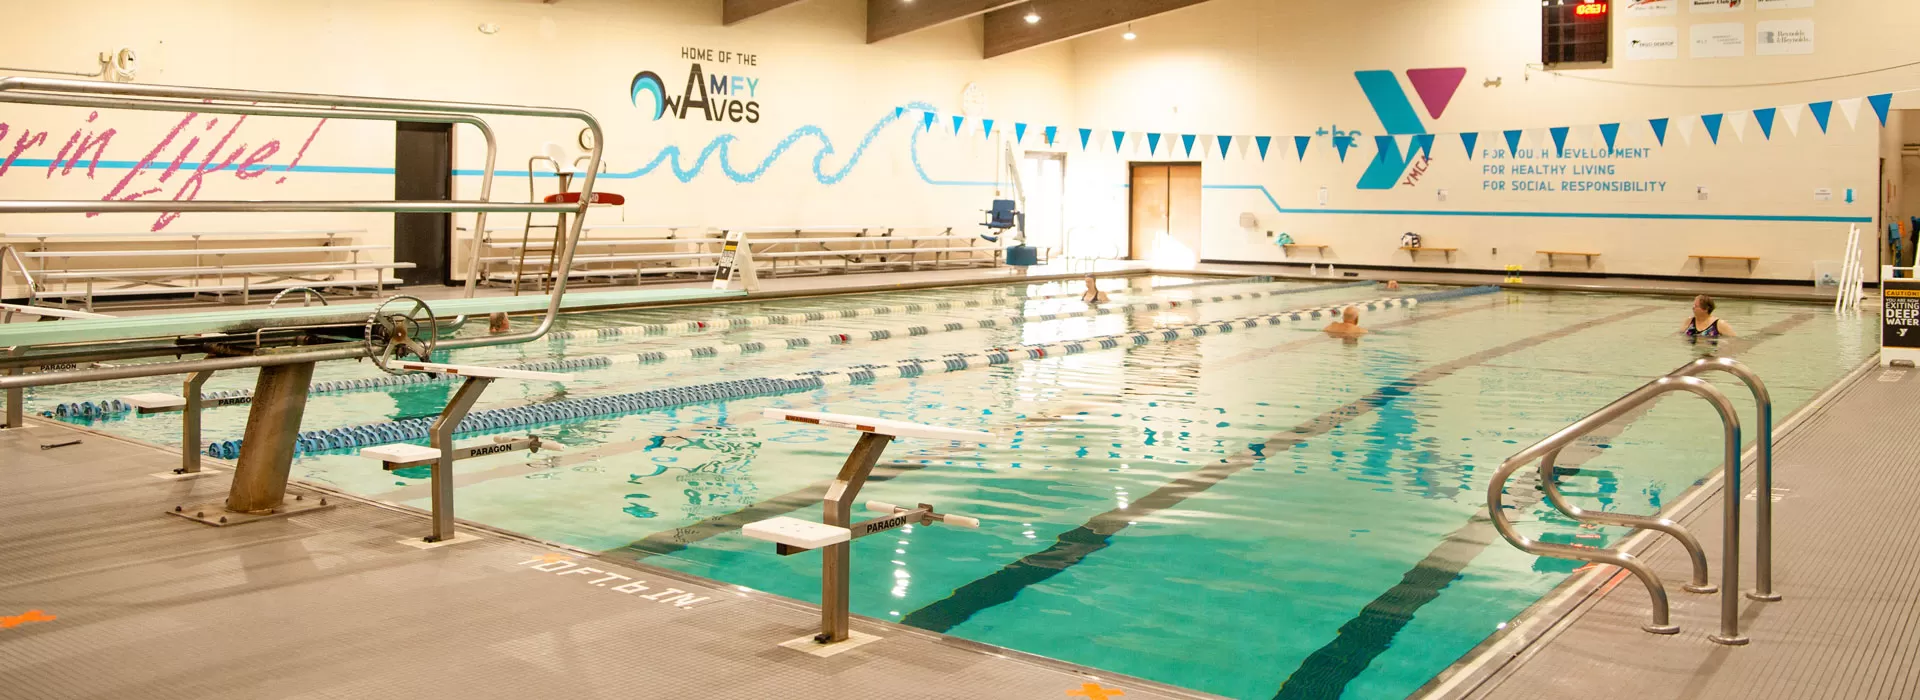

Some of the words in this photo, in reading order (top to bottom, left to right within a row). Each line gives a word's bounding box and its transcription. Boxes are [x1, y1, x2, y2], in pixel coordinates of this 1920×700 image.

[681, 46, 713, 62] HOME
[718, 50, 731, 63] OF
[736, 53, 757, 66] THE
[1483, 149, 1505, 159] FOR
[1483, 165, 1505, 175] FOR
[1511, 165, 1567, 175] HEALTHY
[1573, 165, 1615, 175] LIVING
[1483, 181, 1506, 191] FOR
[1511, 181, 1555, 191] SOCIAL
[1561, 181, 1666, 192] RESPONSIBILITY
[1885, 309, 1920, 318] DEEP
[1886, 318, 1920, 326] WATER
[218, 397, 253, 406] PARAGO
[470, 443, 512, 457] PARAGON
[866, 516, 907, 533] PARAGON
